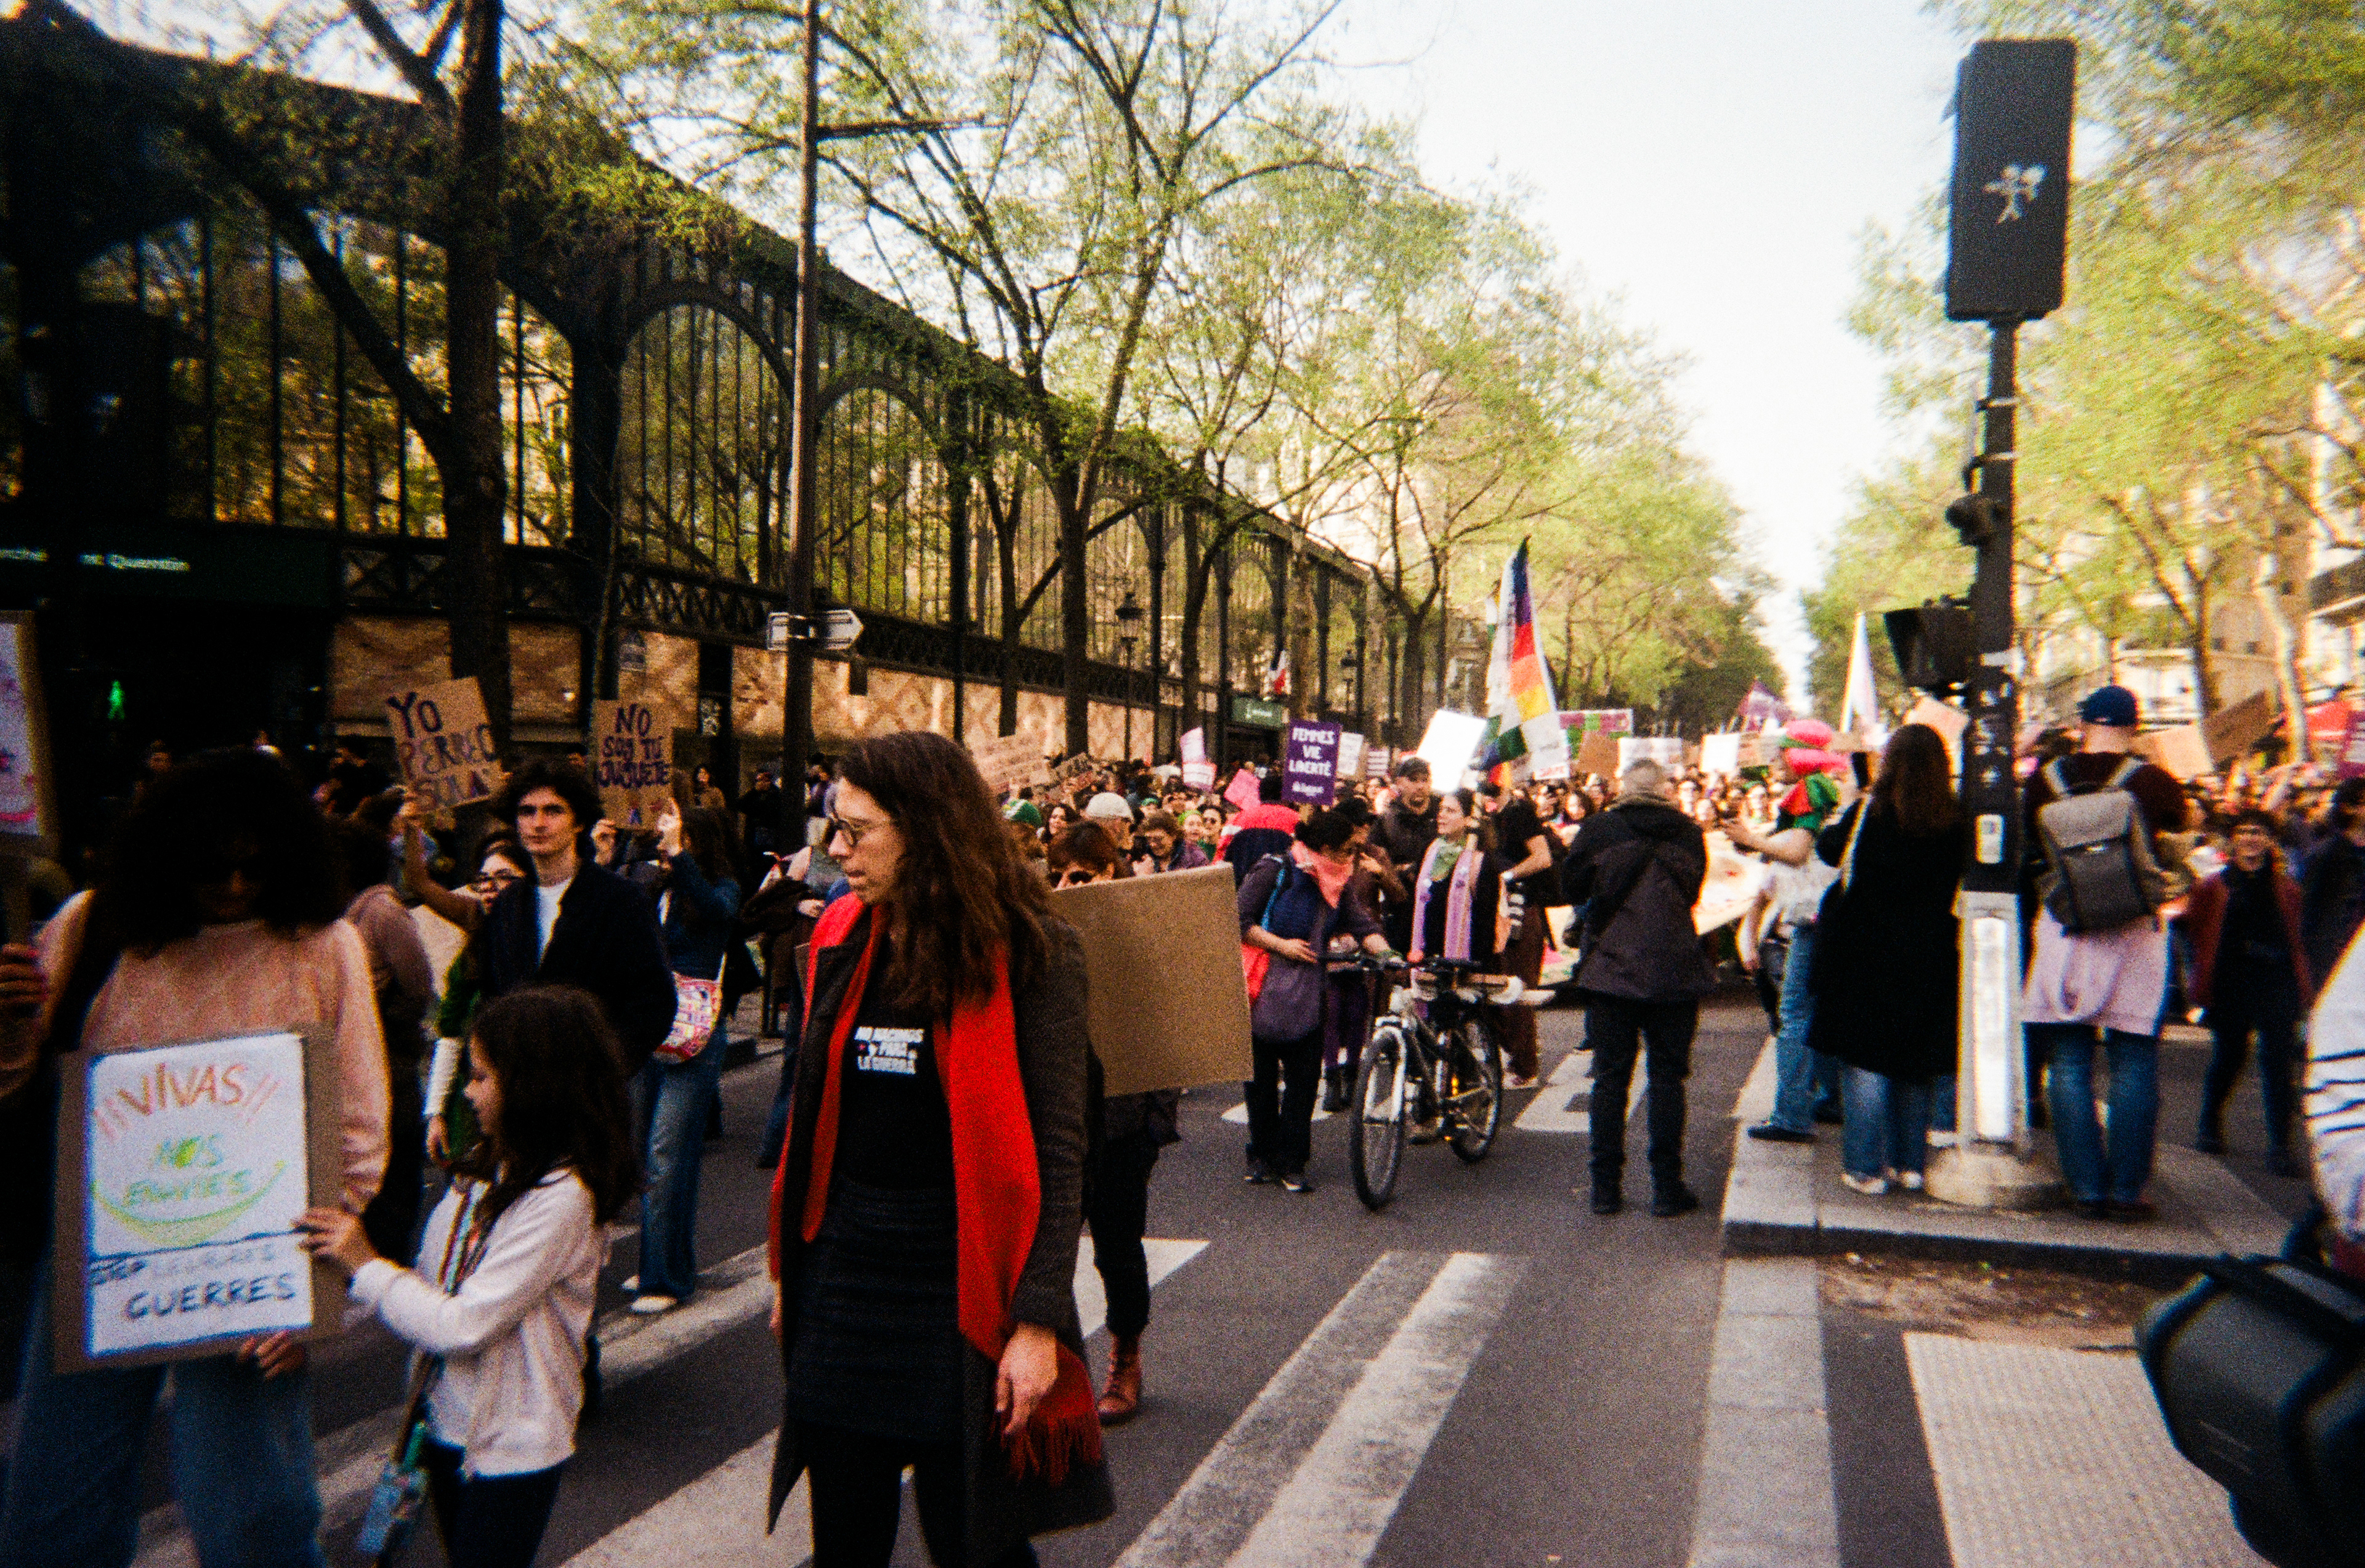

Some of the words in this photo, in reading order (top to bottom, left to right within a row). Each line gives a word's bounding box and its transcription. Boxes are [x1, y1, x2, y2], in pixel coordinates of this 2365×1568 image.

[387, 692, 442, 738] YO
[615, 703, 652, 737] NO
[1292, 727, 1335, 745] FEMMES
[1301, 745, 1323, 759] VIE
[125, 1272, 298, 1320] GUERRES
